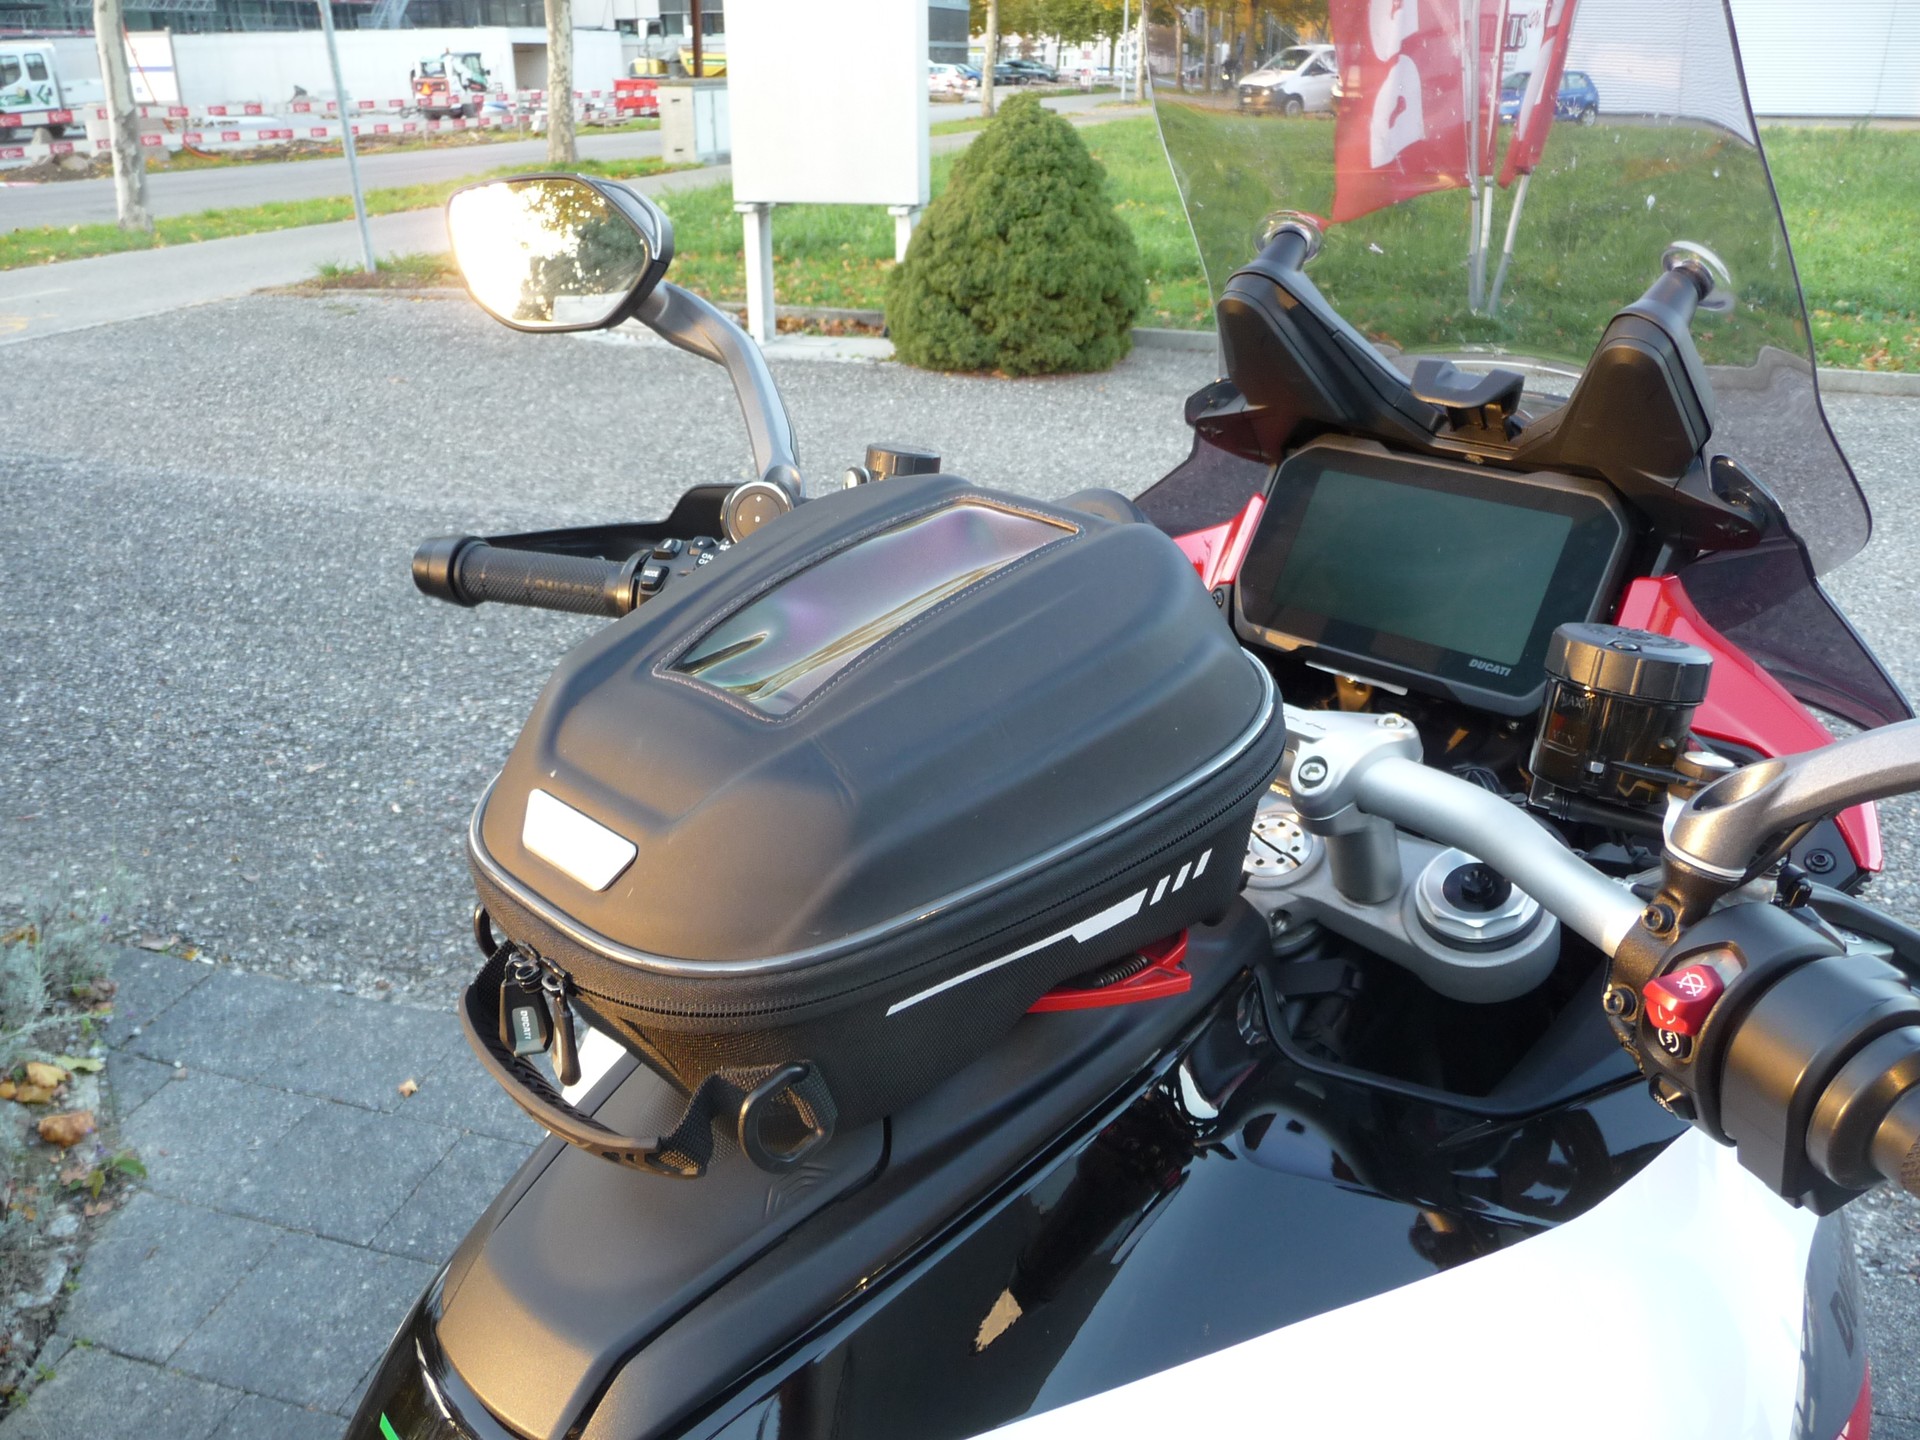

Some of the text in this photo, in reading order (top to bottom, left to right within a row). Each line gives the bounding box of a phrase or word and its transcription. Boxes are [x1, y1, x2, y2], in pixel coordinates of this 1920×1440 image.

[701, 552, 714, 561] ON
[643, 569, 660, 578] MODE
[1469, 658, 1511, 676] DUCATI
[520, 1010, 531, 1040] DUCATI
